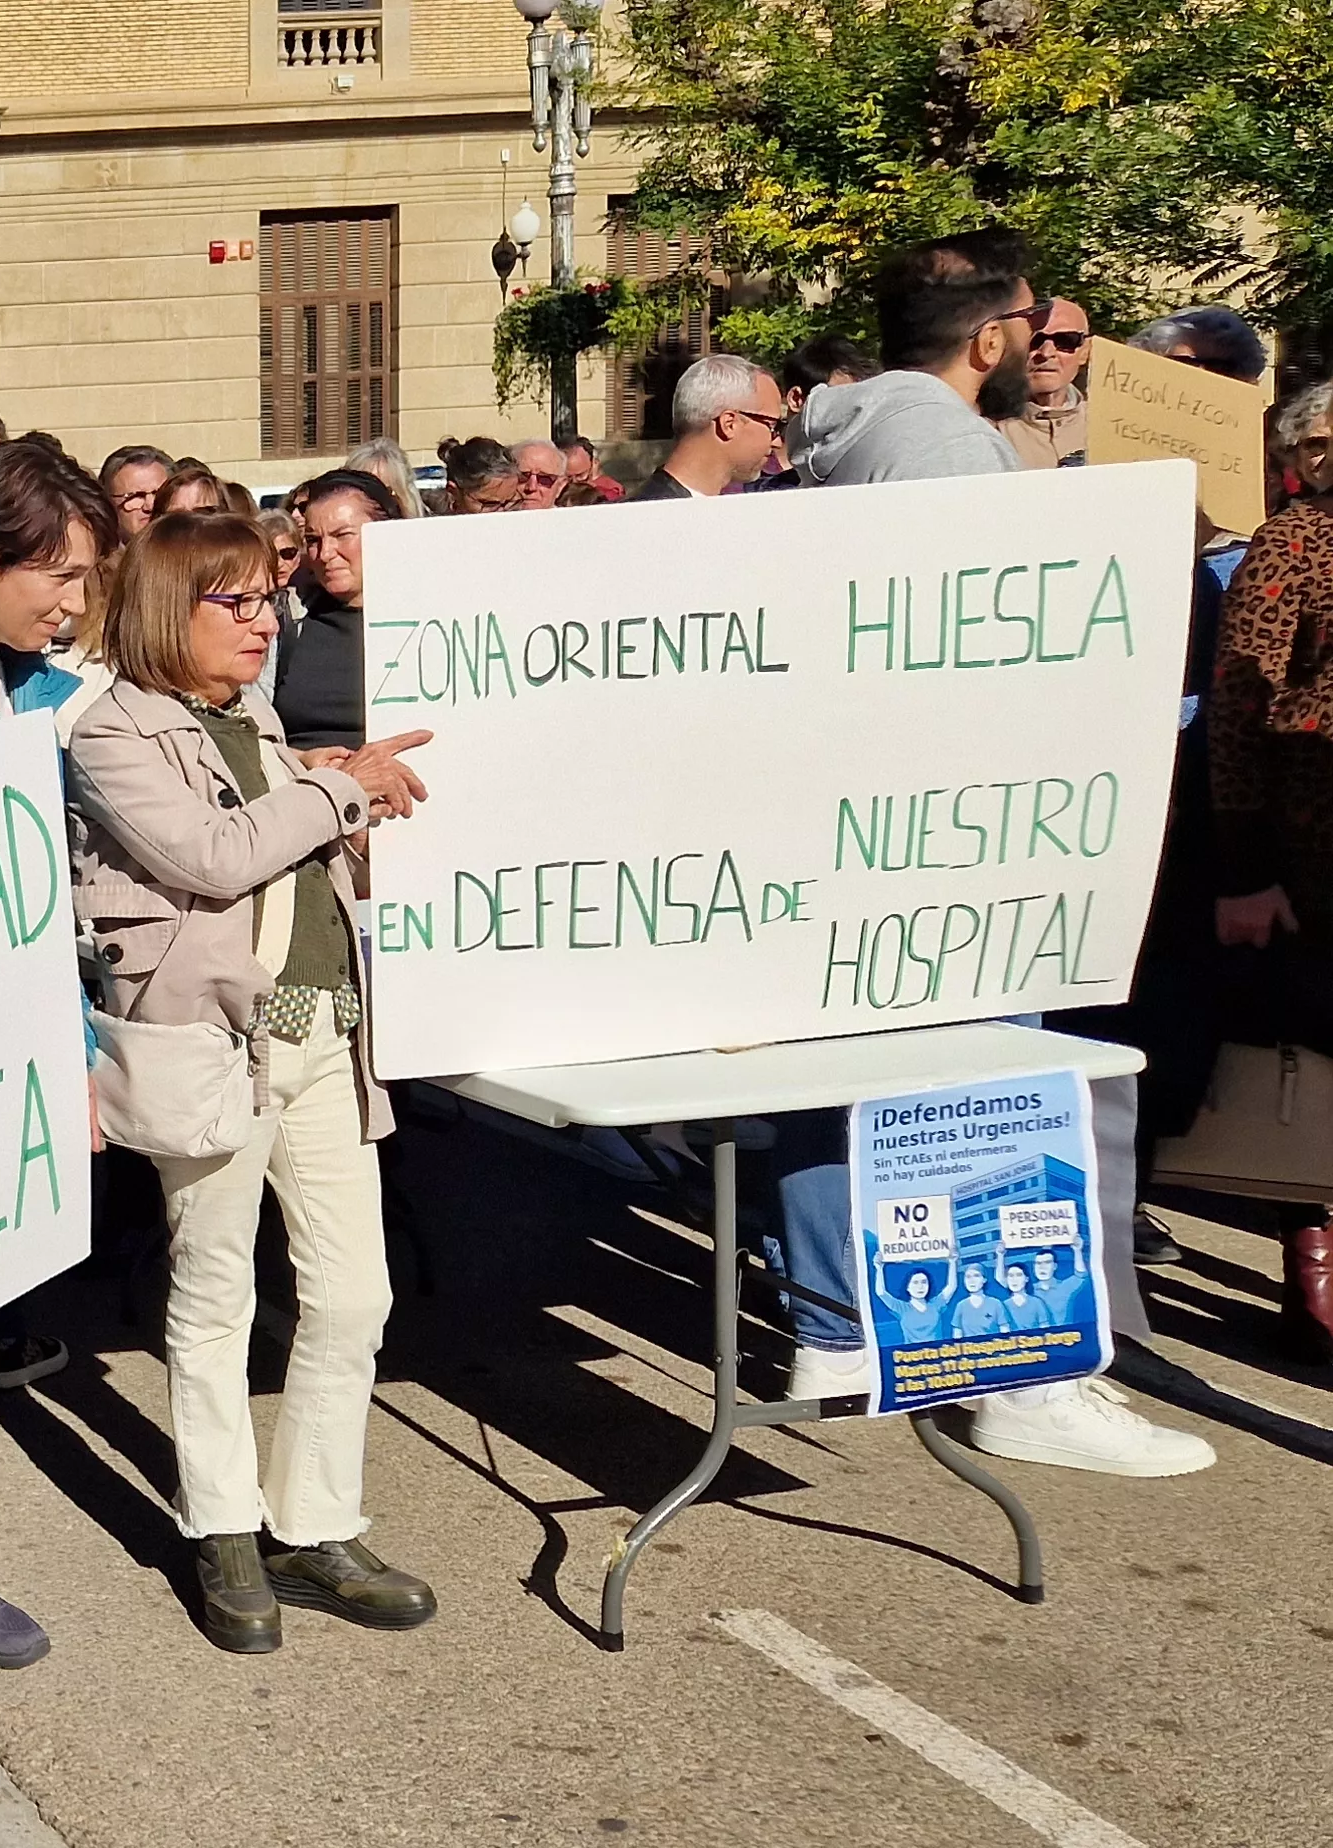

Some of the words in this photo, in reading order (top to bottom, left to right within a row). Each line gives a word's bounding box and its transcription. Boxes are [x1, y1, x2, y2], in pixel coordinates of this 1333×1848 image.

[1219, 452, 1243, 475] DE
[369, 611, 518, 707] ZONA
[523, 607, 789, 687] ORIENTAL
[845, 554, 1134, 674] HUESCA
[835, 771, 1118, 872] NUESTRO
[379, 900, 433, 954] EN
[454, 850, 753, 953] DEFENSA
[760, 879, 819, 926] DE
[822, 890, 1116, 1009] HOSPITAL
[873, 1093, 1042, 1132] ¡Defendamos
[873, 1129, 958, 1151] nuestras
[963, 1111, 1071, 1141] Urgencias!
[874, 1158, 892, 1169] Sin
[897, 1153, 932, 1166] TCAEs
[936, 1150, 947, 1161] ni
[950, 1144, 1018, 1160] enfermeras
[874, 1172, 890, 1183] no
[893, 1169, 915, 1182] hay
[918, 1163, 973, 1178] cuidados
[956, 1178, 993, 1195] HOSPITAL
[994, 1171, 1012, 1183] SAN
[894, 1203, 929, 1224] NO
[898, 1228, 908, 1240] A
[912, 1226, 930, 1238] LA
[1020, 1224, 1069, 1239] ESPERA
[893, 1348, 939, 1363] Puerta
[940, 1343, 960, 1357] del
[963, 1337, 1018, 1355] Hospital
[1018, 1335, 1043, 1348] San
[1044, 1331, 1081, 1346] Jorge
[895, 1363, 942, 1378] Martes
[944, 1361, 957, 1373] 11
[959, 1358, 976, 1370] de
[976, 1352, 1048, 1369] noviembre
[895, 1383, 905, 1393] a
[906, 1379, 925, 1391] las
[964, 1372, 975, 1384] h
